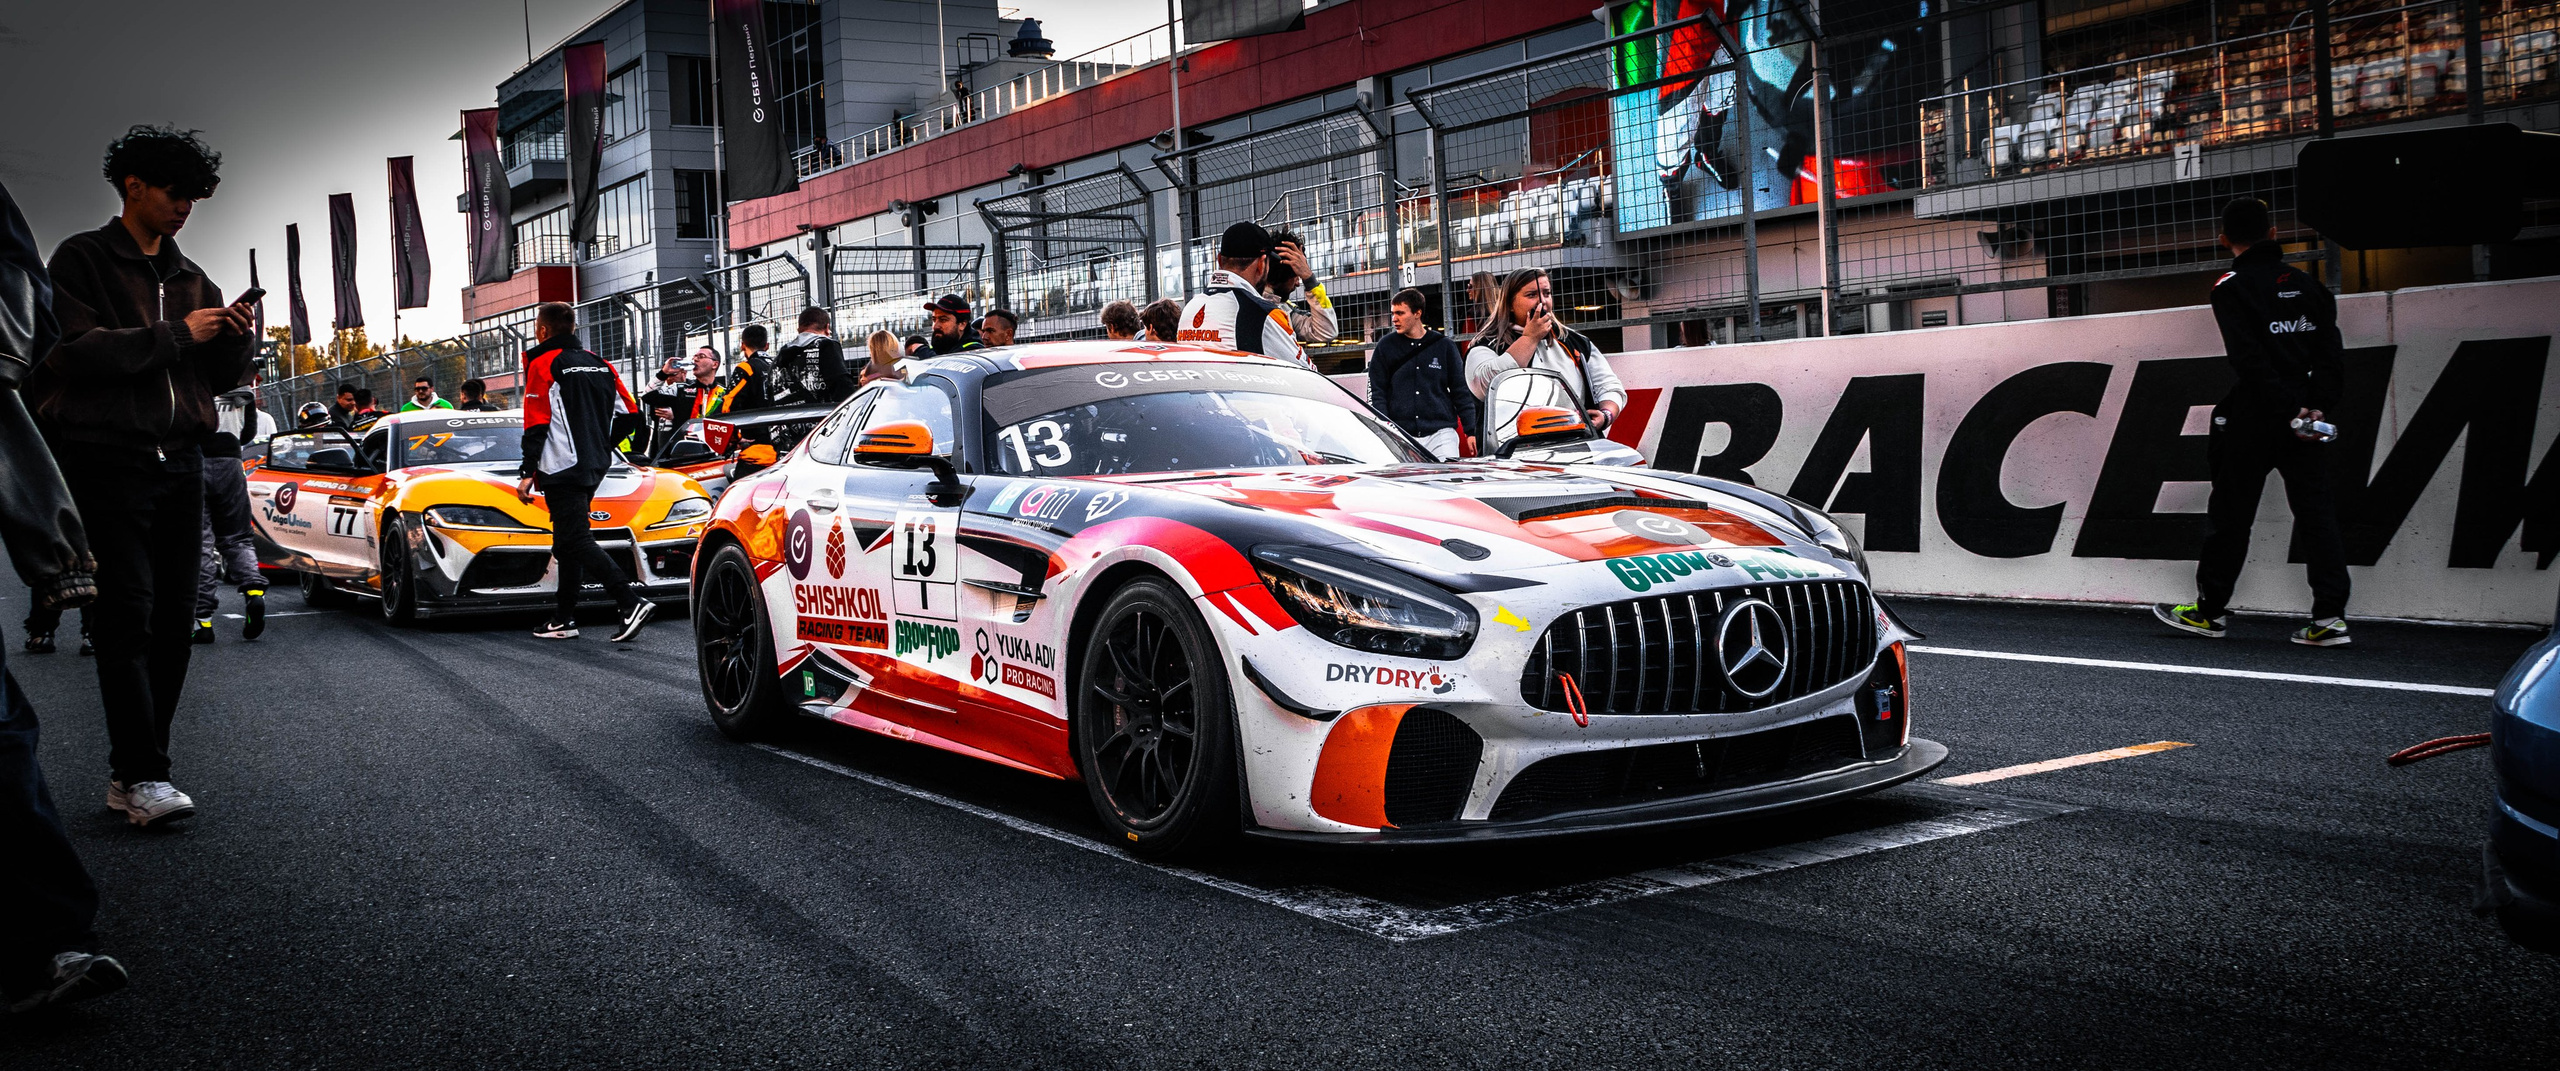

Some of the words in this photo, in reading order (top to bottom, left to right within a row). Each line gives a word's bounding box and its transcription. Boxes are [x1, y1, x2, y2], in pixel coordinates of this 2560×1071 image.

[742, 24, 757, 68] Первый
[751, 71, 761, 105] СБЕР
[2181, 150, 2193, 176] 7
[483, 162, 491, 193] Первый
[1406, 266, 1413, 284] 6
[2269, 320, 2299, 334] GNV
[562, 366, 610, 375] PORSCHE
[1132, 369, 1201, 382] СБЕР
[1204, 369, 1292, 388] Первый
[409, 432, 453, 451] 77
[998, 420, 1072, 473] 13
[995, 486, 1019, 506] IP
[334, 507, 358, 535] 77
[903, 516, 936, 577] 13
[1605, 552, 1714, 593] GROW
[795, 584, 888, 621] SHISHKOIL
[799, 620, 843, 640] RACING
[848, 623, 886, 644] TEAM
[996, 633, 1034, 664] YUKA
[1034, 642, 1056, 672] ADV
[804, 676, 814, 692] IP
[1006, 667, 1024, 685] PRO
[1025, 672, 1054, 696] RACING
[1326, 663, 1427, 690] DRYDRY
